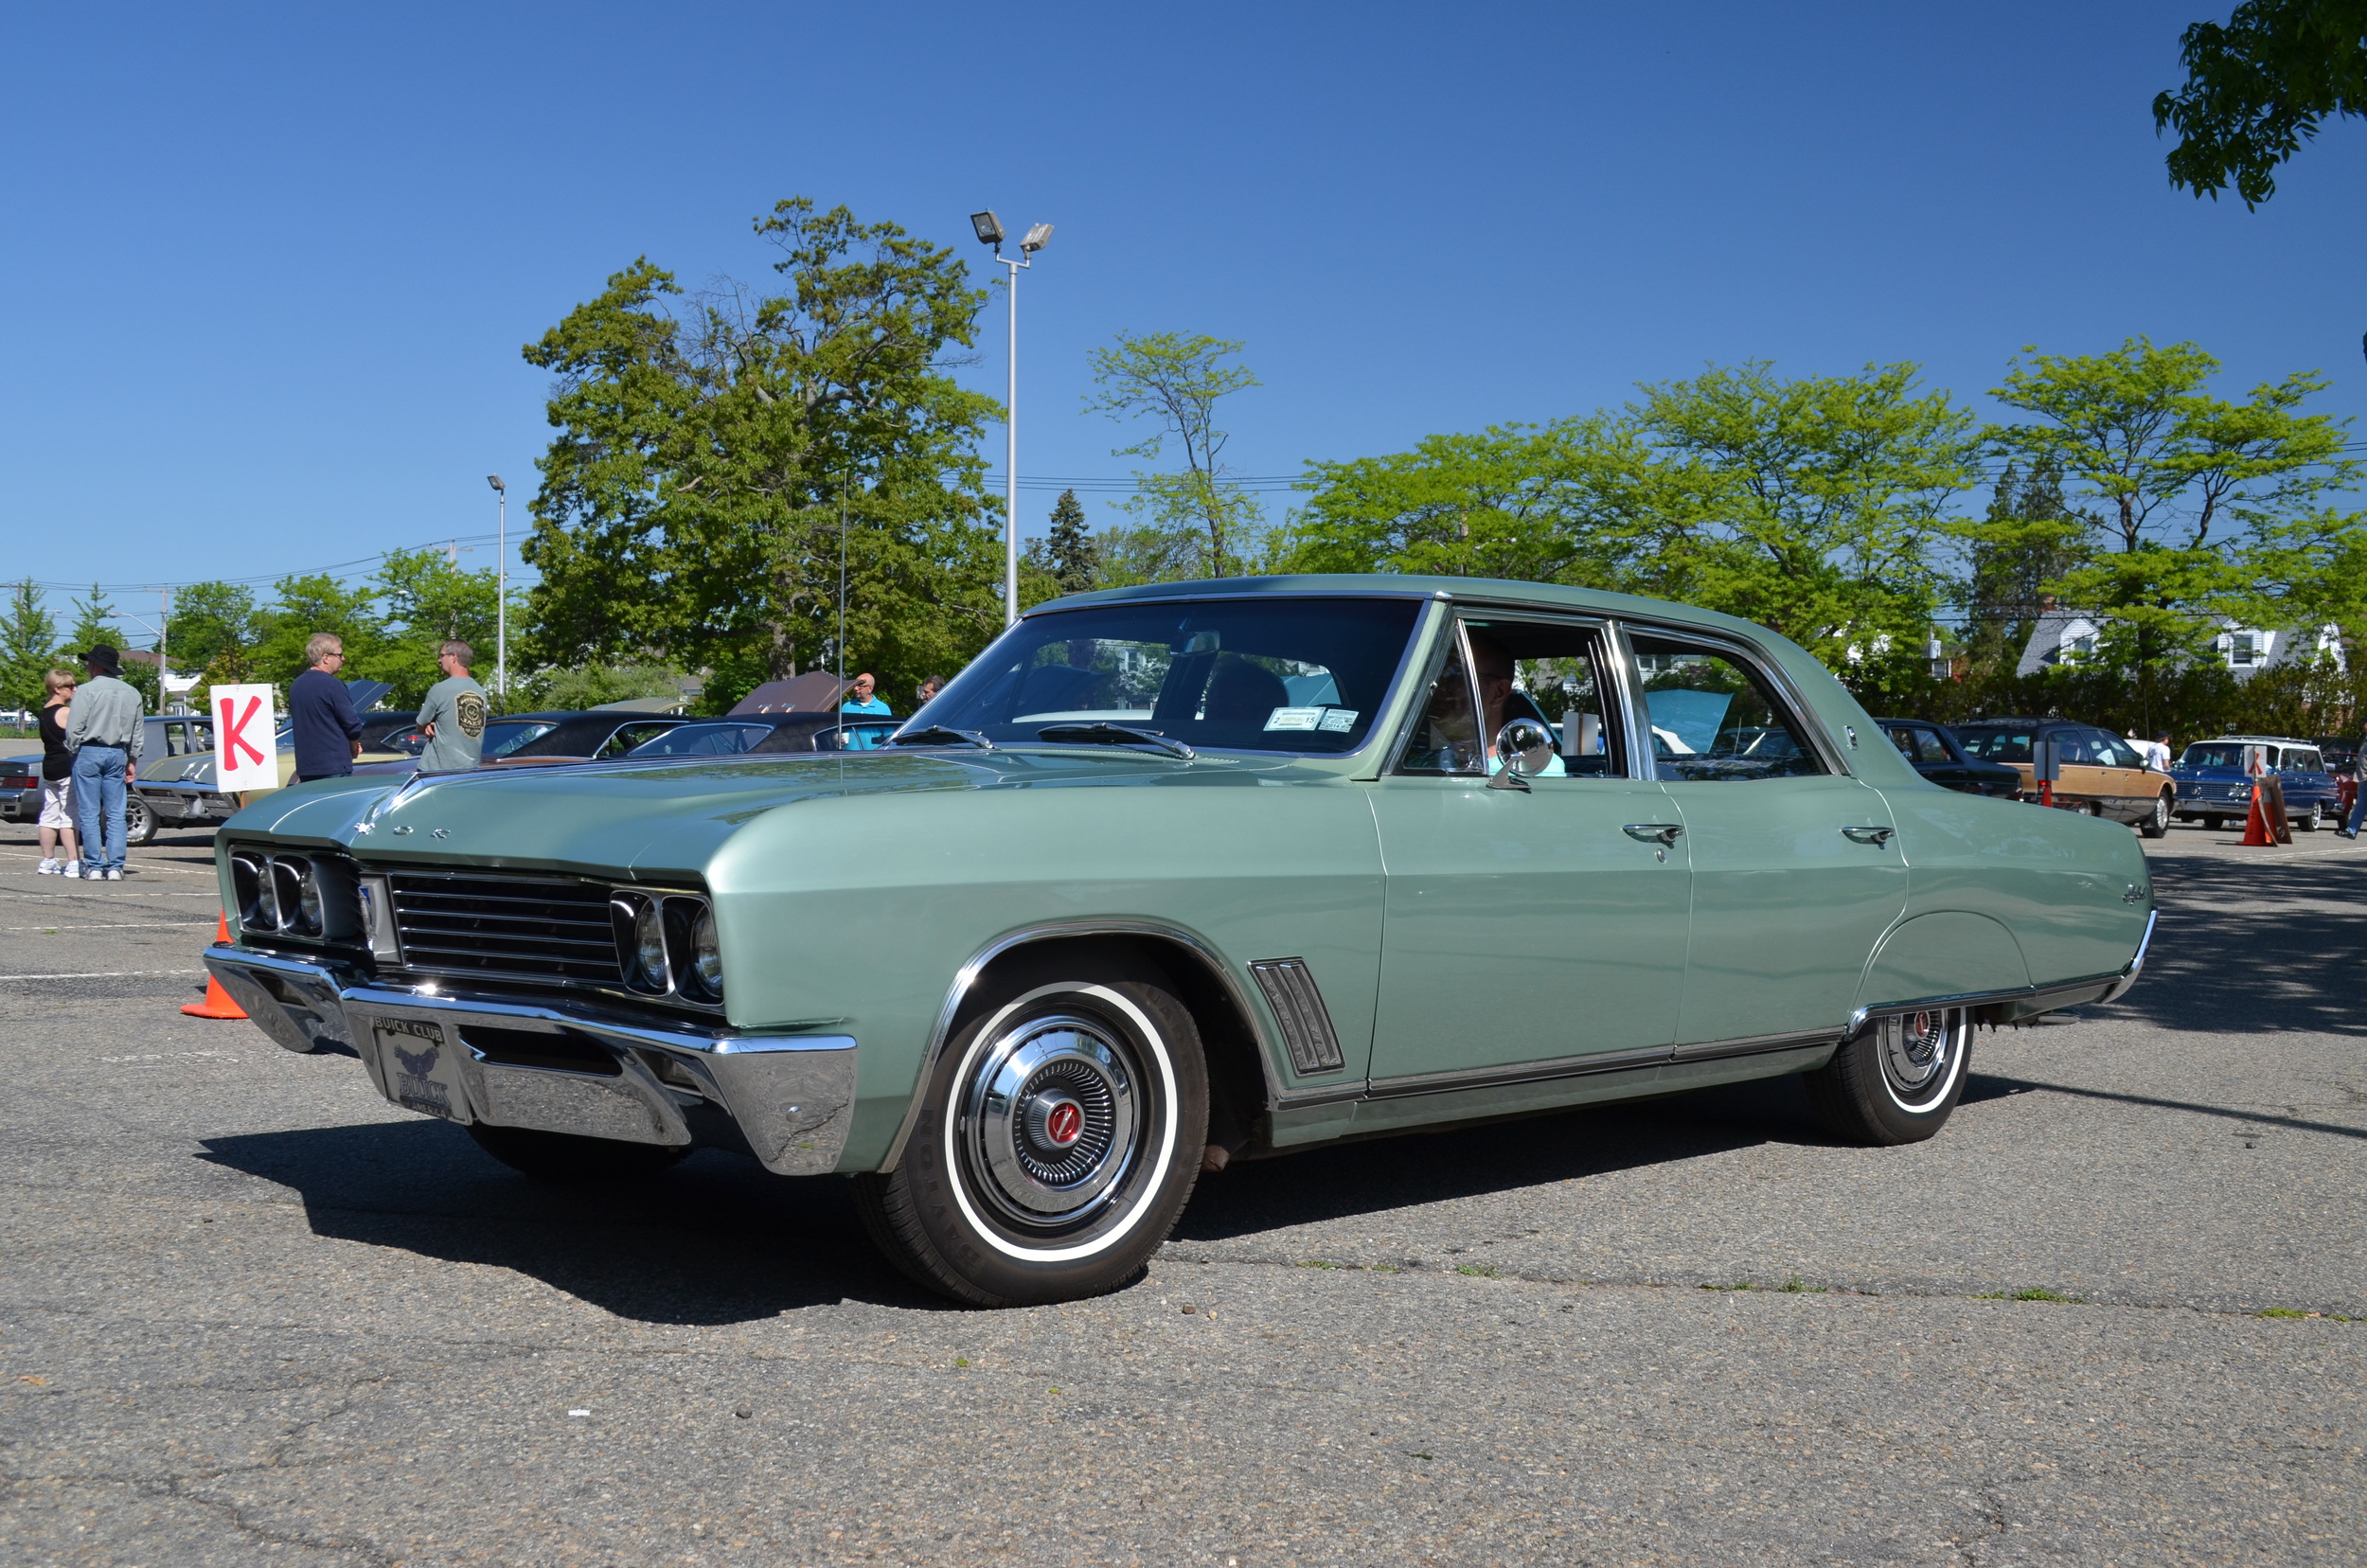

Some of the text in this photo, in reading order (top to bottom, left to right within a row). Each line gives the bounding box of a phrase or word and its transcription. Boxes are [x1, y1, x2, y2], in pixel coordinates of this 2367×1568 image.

[219, 695, 265, 772] K
[375, 1017, 443, 1042] BUICK CLUB
[397, 1073, 452, 1108] BUICK
[412, 1101, 447, 1118] AMERICA
[919, 1109, 981, 1267] DAYTON
